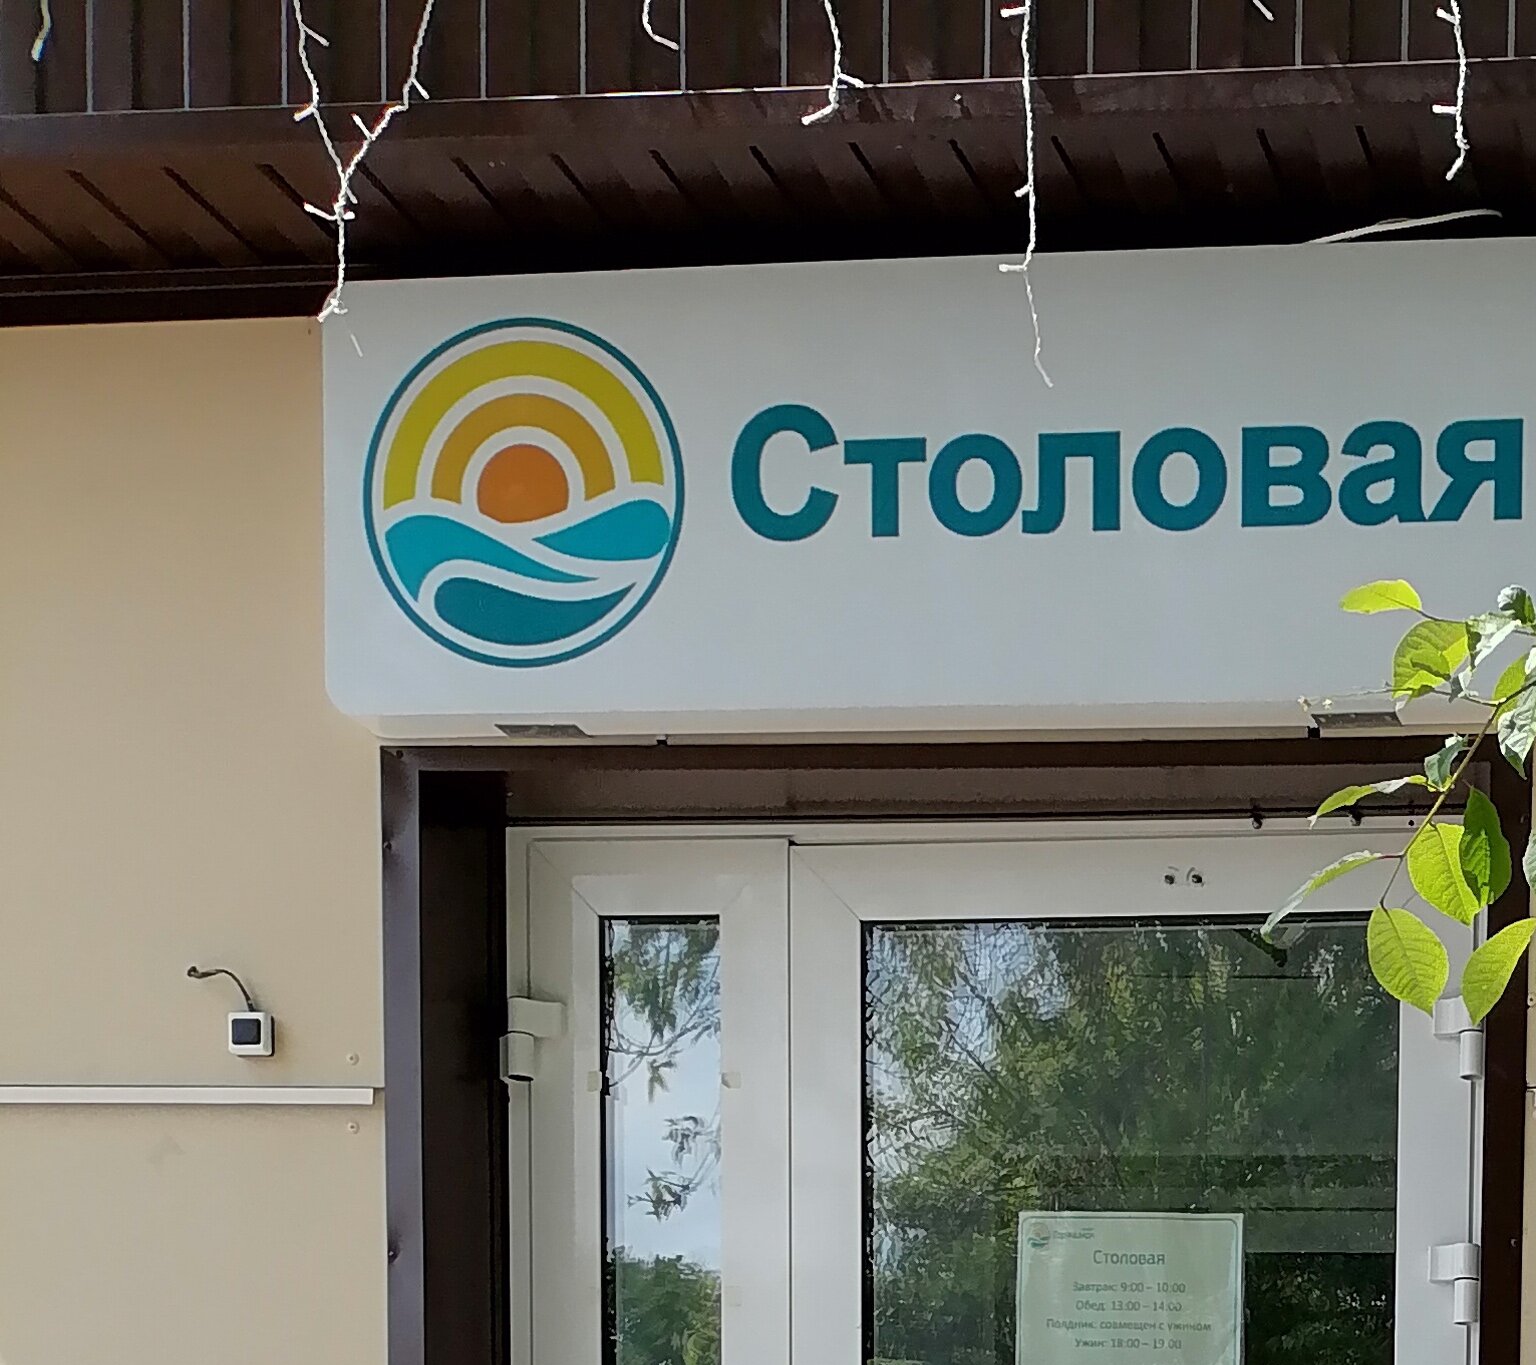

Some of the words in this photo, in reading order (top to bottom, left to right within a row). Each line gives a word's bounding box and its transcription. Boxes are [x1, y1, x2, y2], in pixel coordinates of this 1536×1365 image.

[730, 401, 1525, 542] Столовая
[1093, 1250, 1165, 1265] Столовая
[1120, 1282, 1144, 1292] 9:00
[1156, 1283, 1186, 1293] 10:00
[1111, 1302, 1141, 1311] 13:00
[1153, 1302, 1182, 1312] 14:00
[1100, 1321, 1156, 1331] совмещен
[1159, 1322, 1164, 1330] с
[1167, 1322, 1211, 1332] ужином
[1111, 1338, 1140, 1348] 18:00
[1153, 1339, 1181, 1349] 19:00
